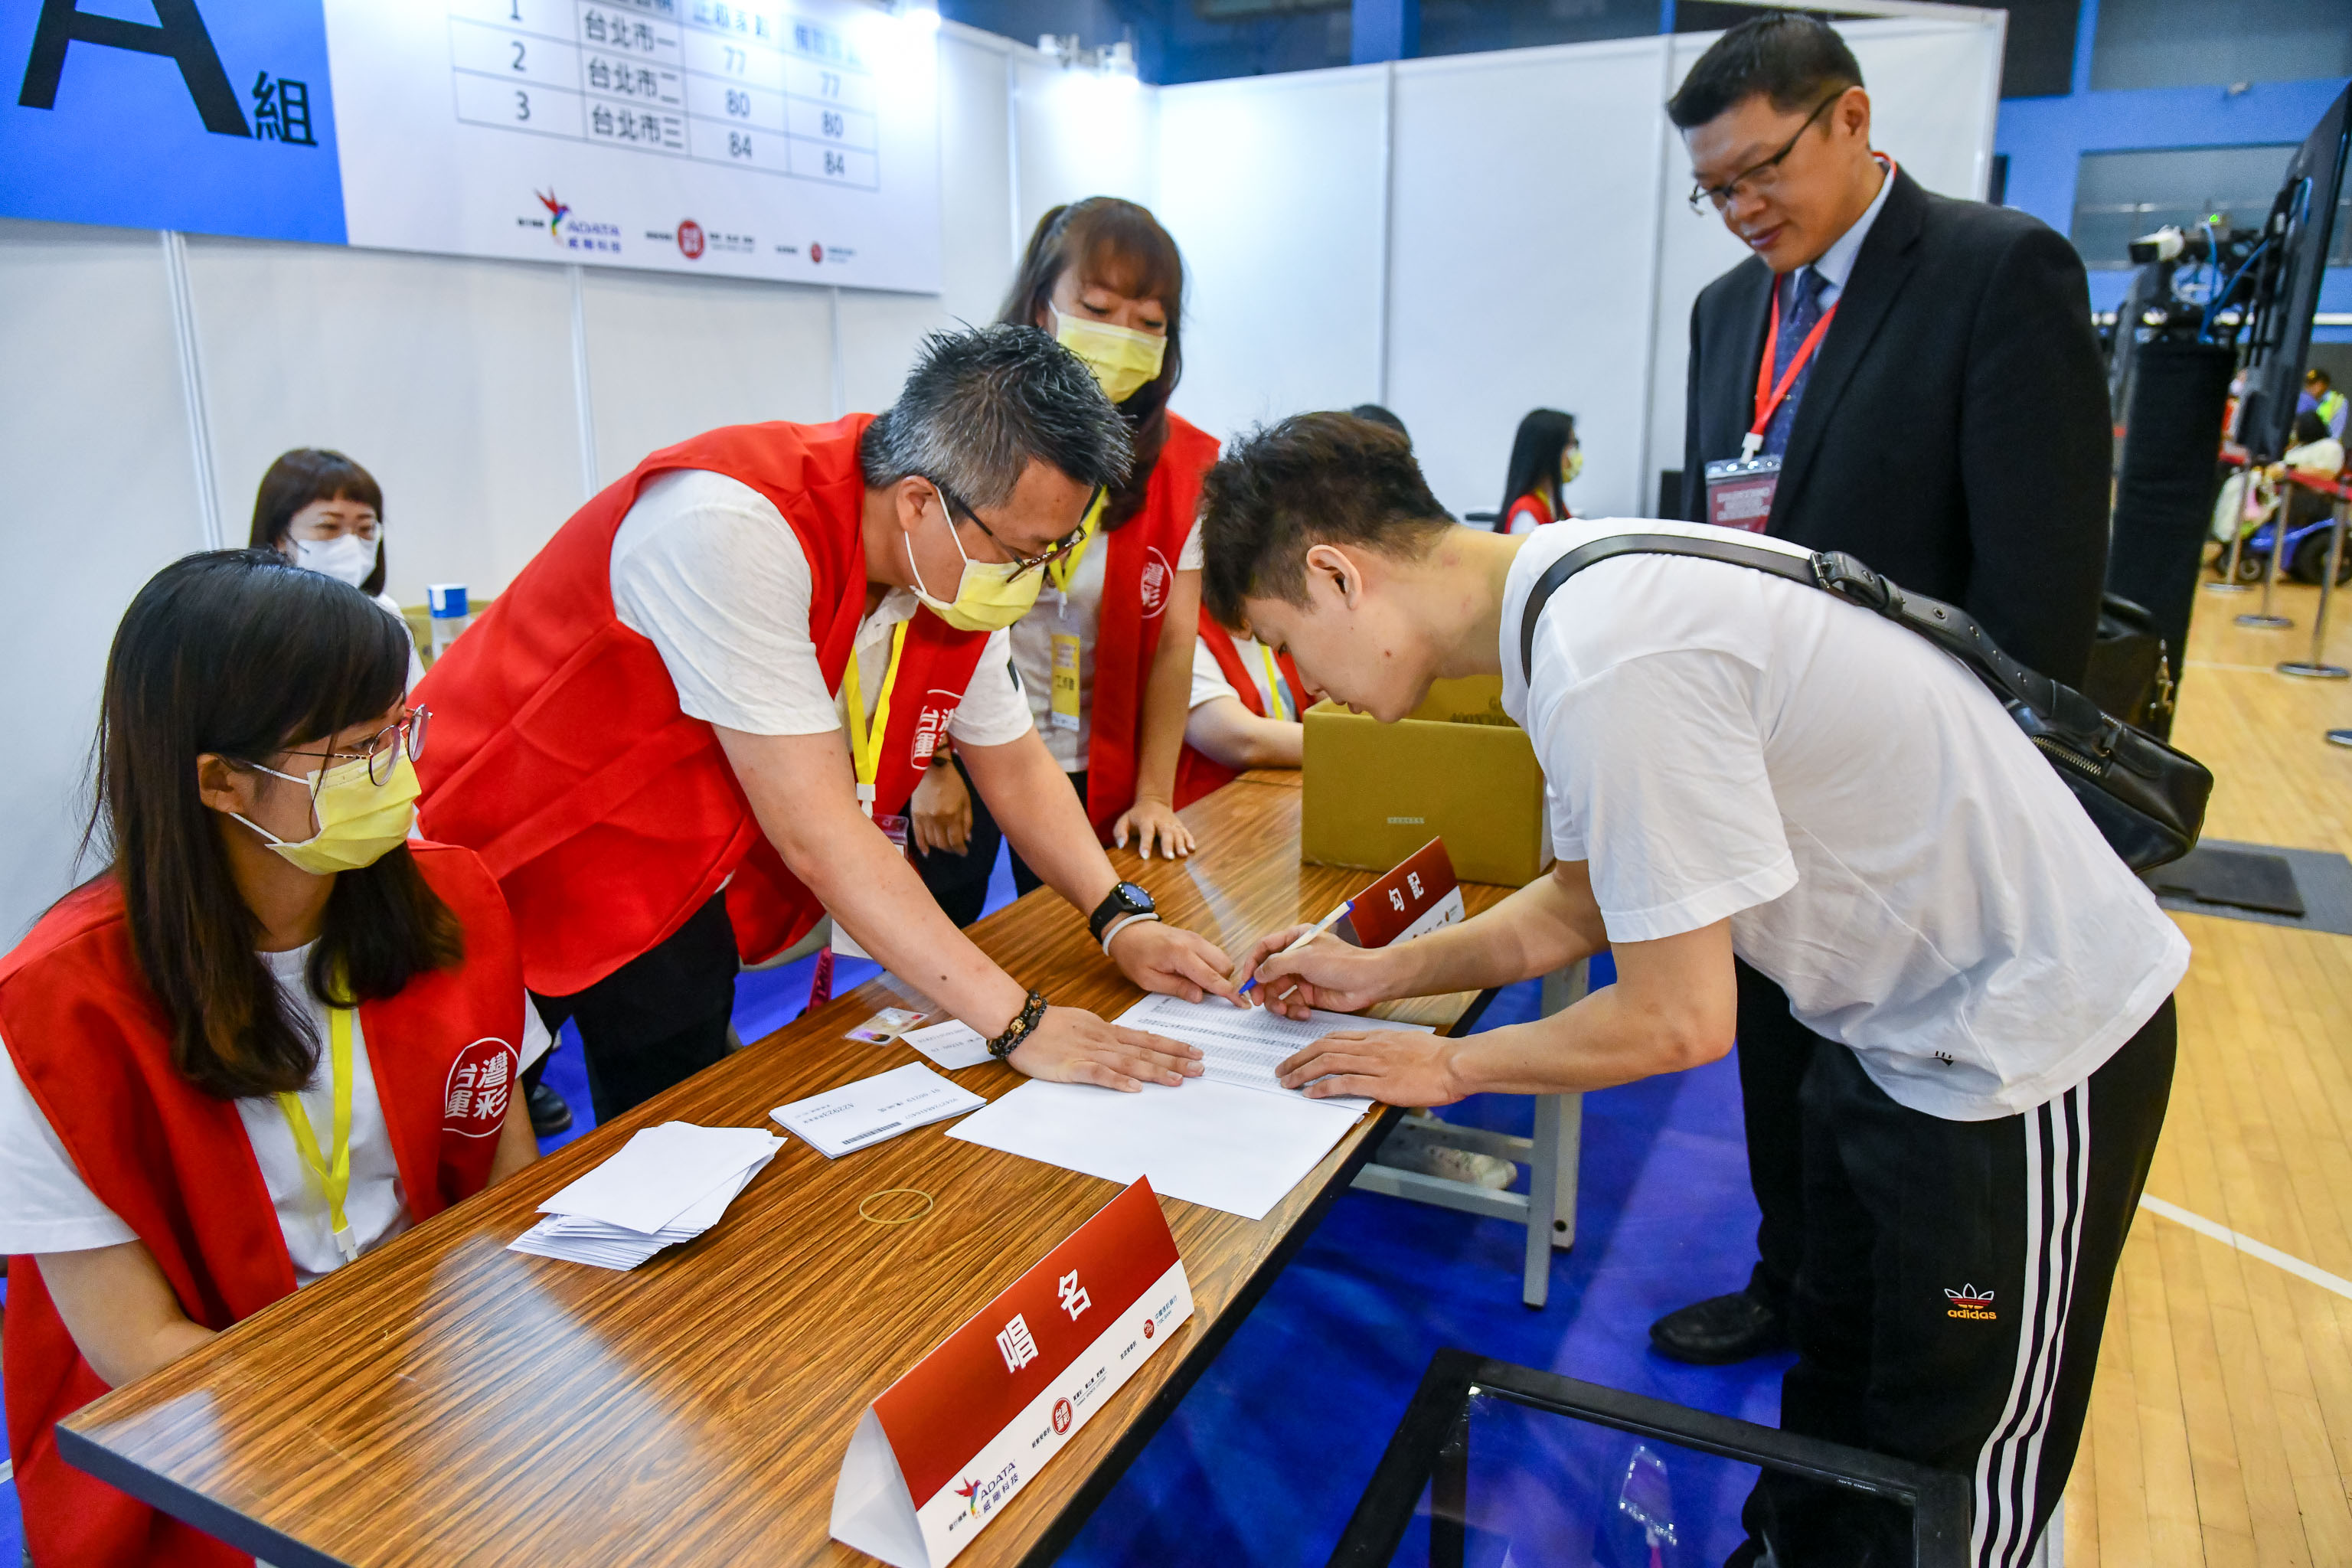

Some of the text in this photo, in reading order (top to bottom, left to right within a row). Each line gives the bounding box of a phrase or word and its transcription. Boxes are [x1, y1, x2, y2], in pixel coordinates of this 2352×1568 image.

[586, 8, 676, 51] 台北市一
[724, 46, 746, 74] 77
[820, 71, 841, 98] 77
[511, 41, 844, 139] 2 台北市二 80 80
[515, 90, 845, 176] 3 台北市三 84 84
[919, 708, 956, 732] 台
[1947, 1309, 1997, 1320] adidas
[981, 1462, 1016, 1501] ADATA
[983, 1472, 1019, 1514] 威剛科技
